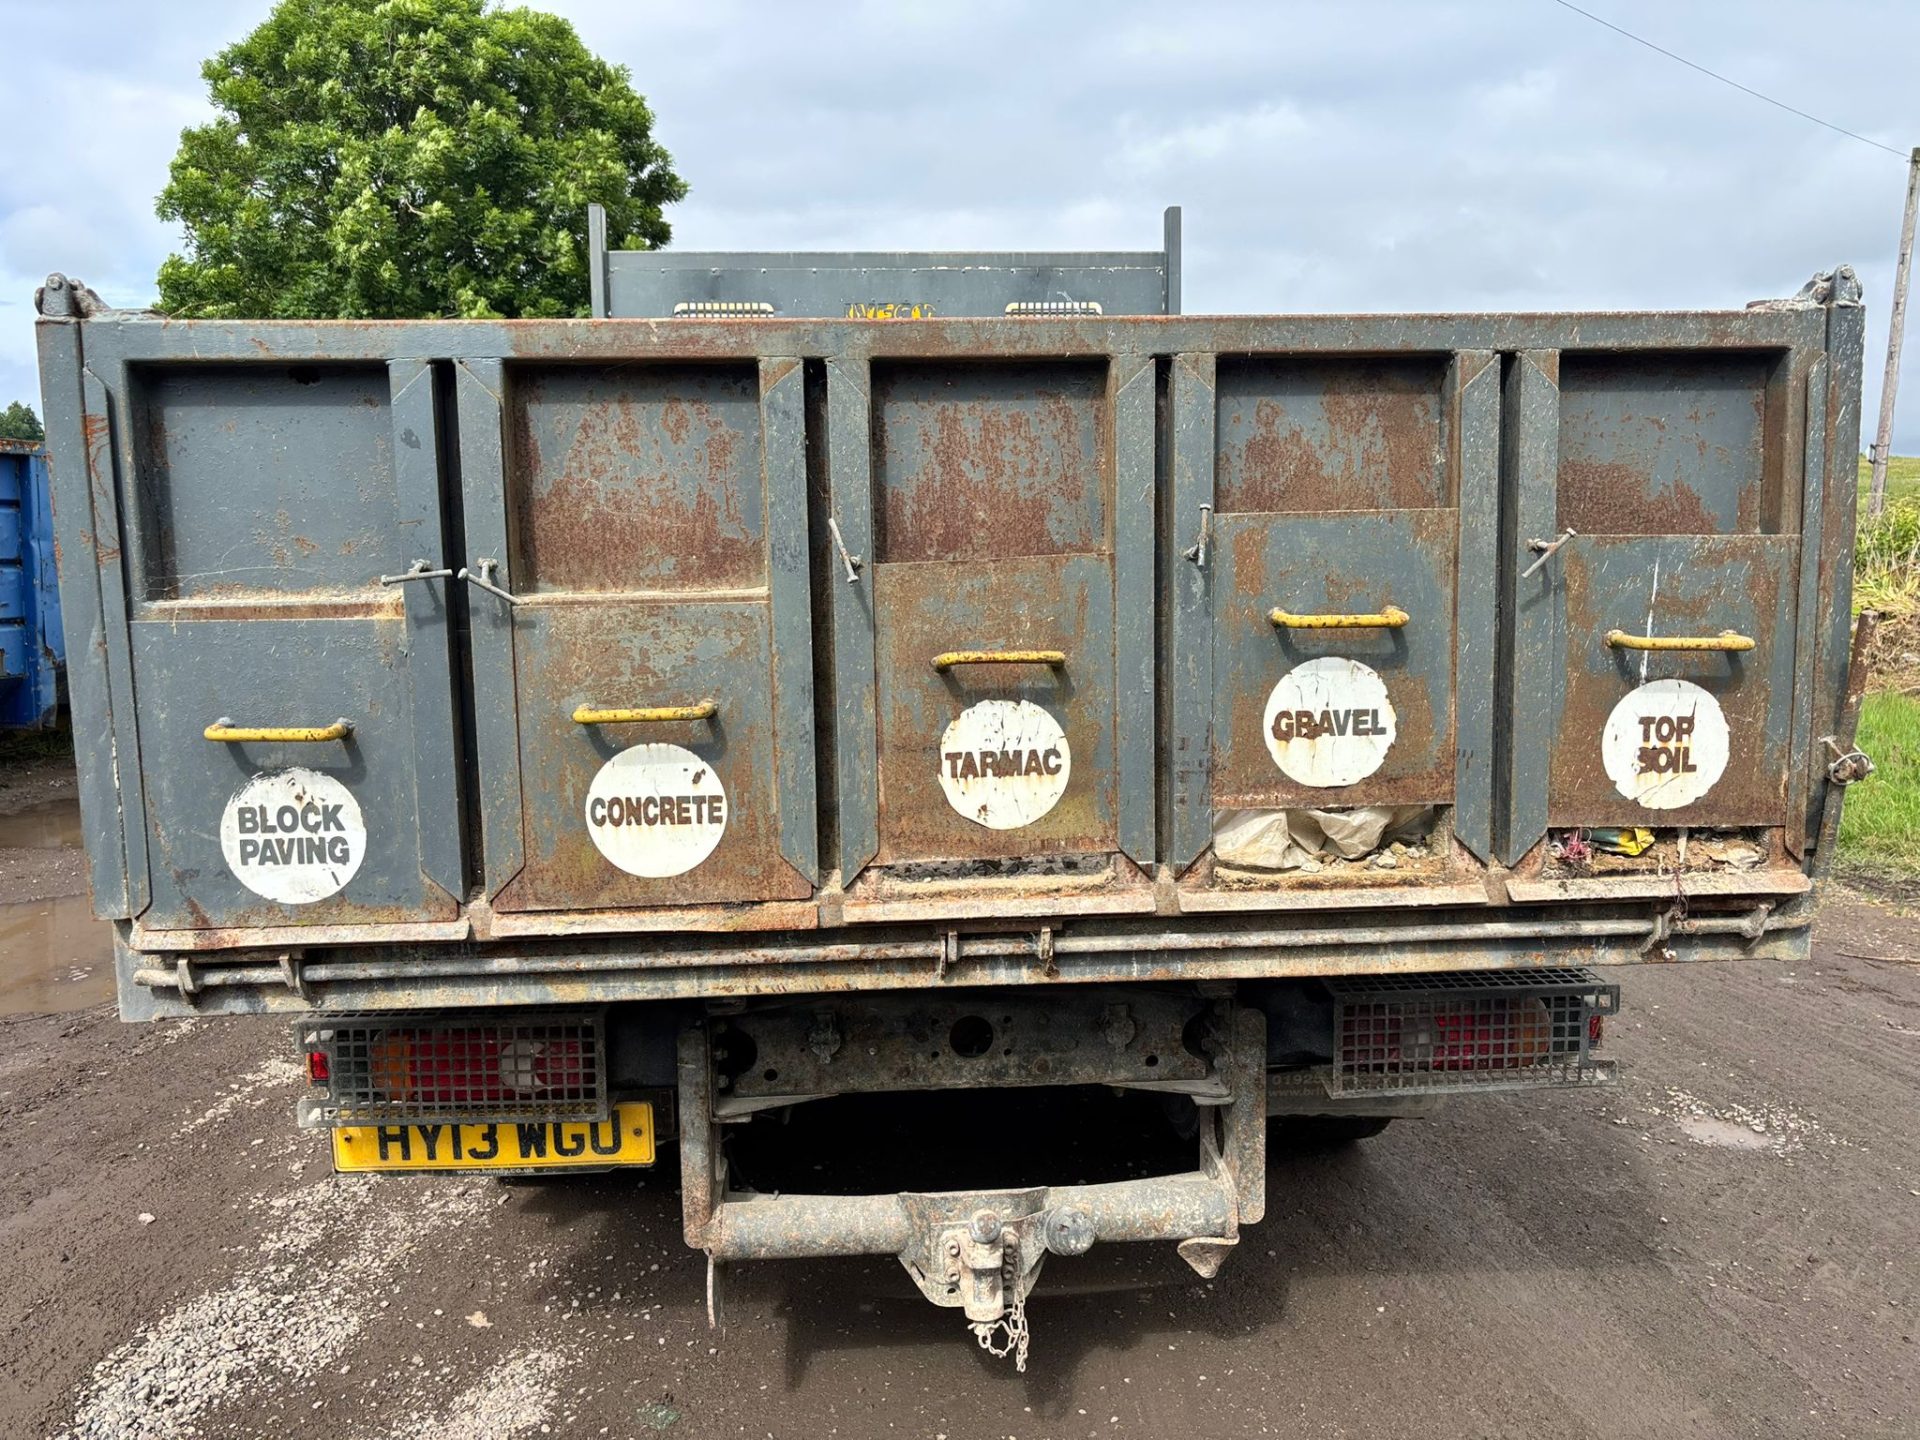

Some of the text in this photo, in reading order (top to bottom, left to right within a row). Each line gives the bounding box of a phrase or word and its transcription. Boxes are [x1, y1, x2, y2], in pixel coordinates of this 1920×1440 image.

[1270, 708, 1387, 742] GRAVEL
[1638, 715, 1695, 743] TOP
[944, 748, 1062, 779] TARMAC
[1637, 746, 1697, 775] SOIL
[237, 804, 346, 835] BLOCK
[590, 795, 724, 828] CONCRETE
[239, 836, 350, 866] PAVING
[377, 1109, 622, 1161] HY13 WGU
[456, 1167, 536, 1177] www.hendy.co.uk
